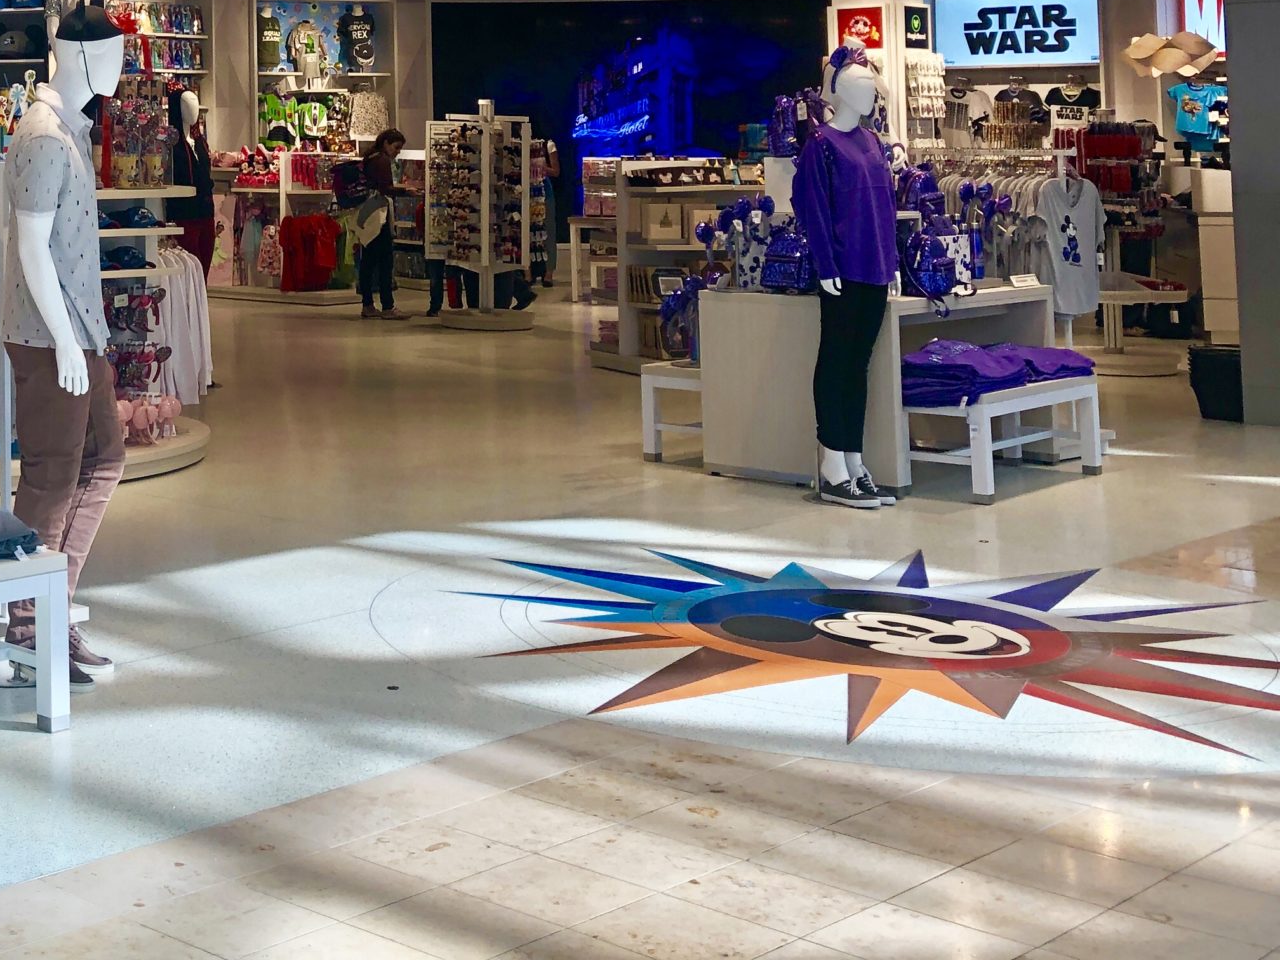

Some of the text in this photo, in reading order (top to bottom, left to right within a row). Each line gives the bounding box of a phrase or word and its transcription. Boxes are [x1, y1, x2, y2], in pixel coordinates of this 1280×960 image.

[963, 3, 1077, 32] STAR
[351, 30, 369, 40] REX
[963, 27, 1077, 56] WARS
